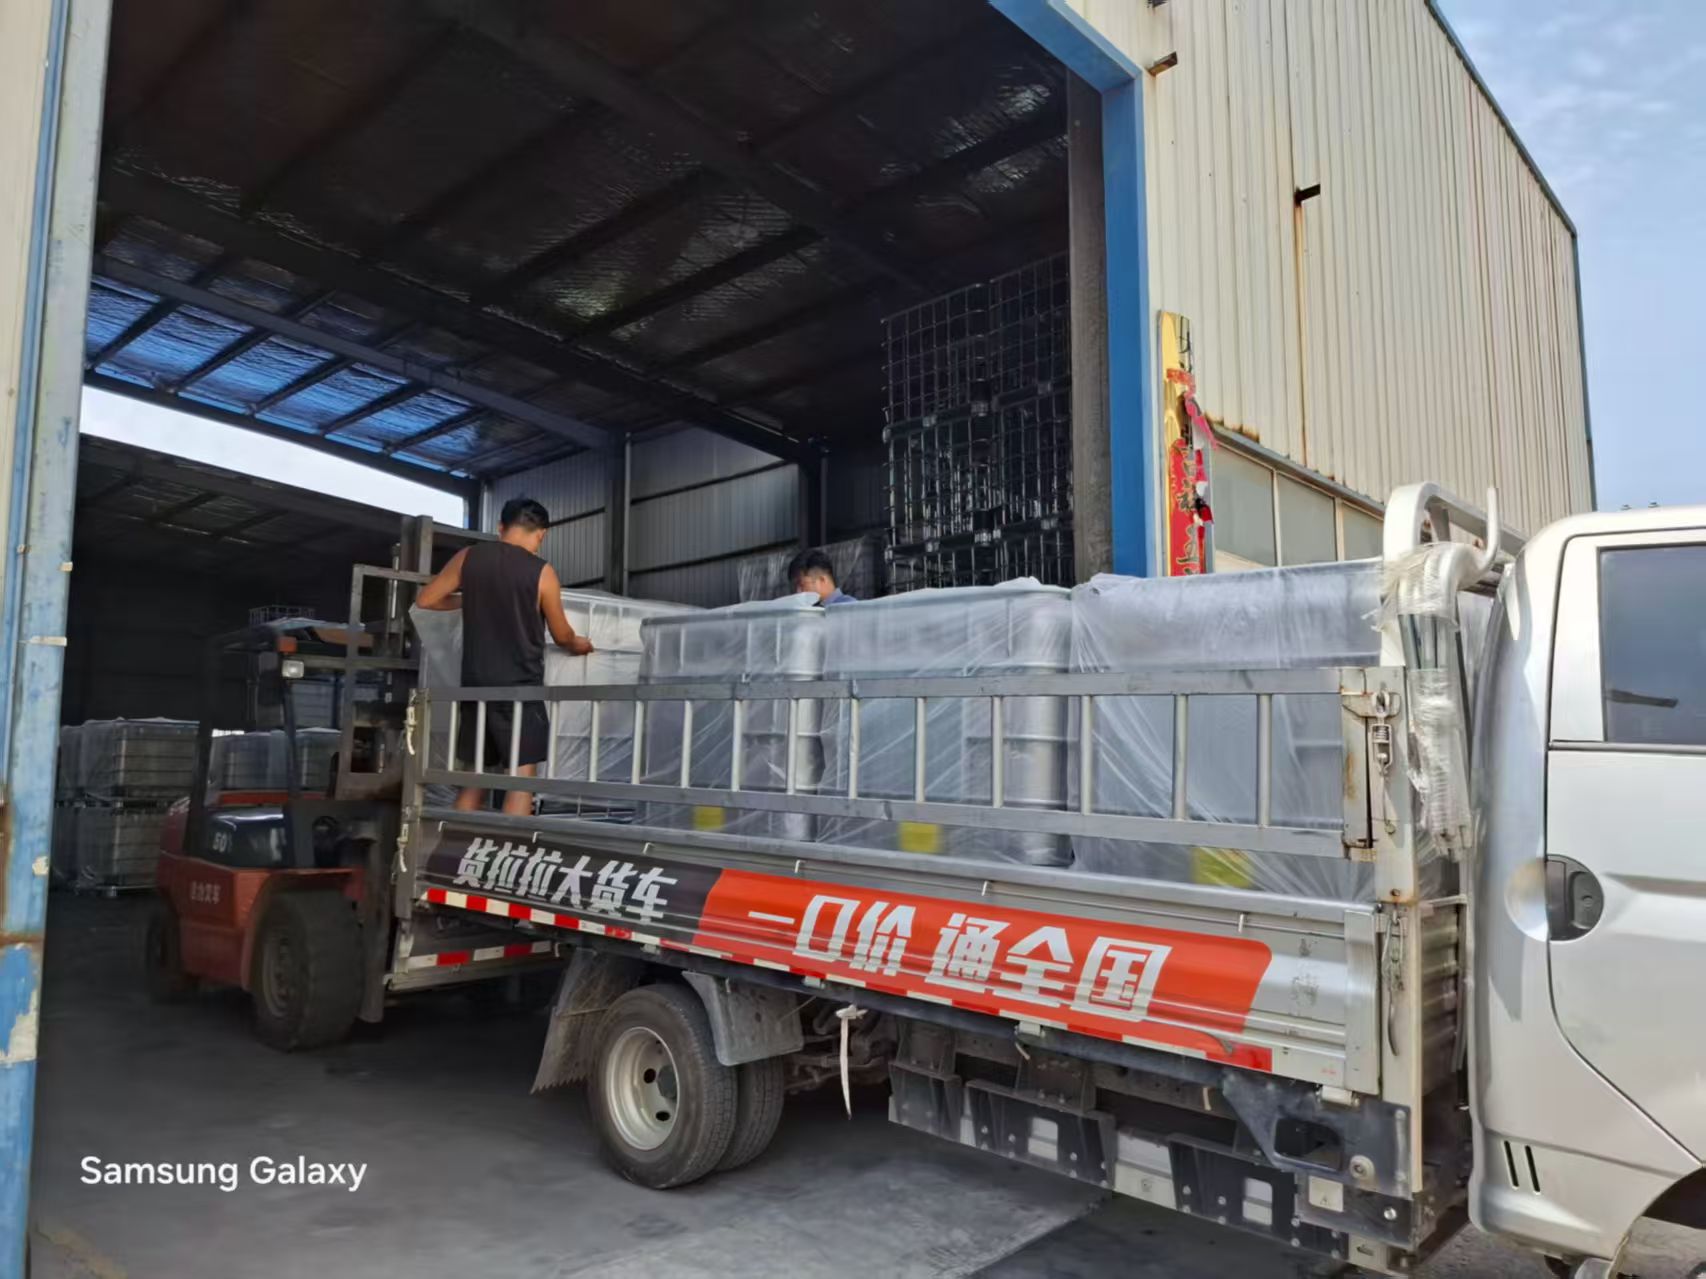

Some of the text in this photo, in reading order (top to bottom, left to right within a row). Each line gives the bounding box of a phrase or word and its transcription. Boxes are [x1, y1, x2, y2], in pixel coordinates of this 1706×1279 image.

[453, 837, 678, 924] 货拉拉大货车
[748, 894, 1173, 1023] 一口价 通全国
